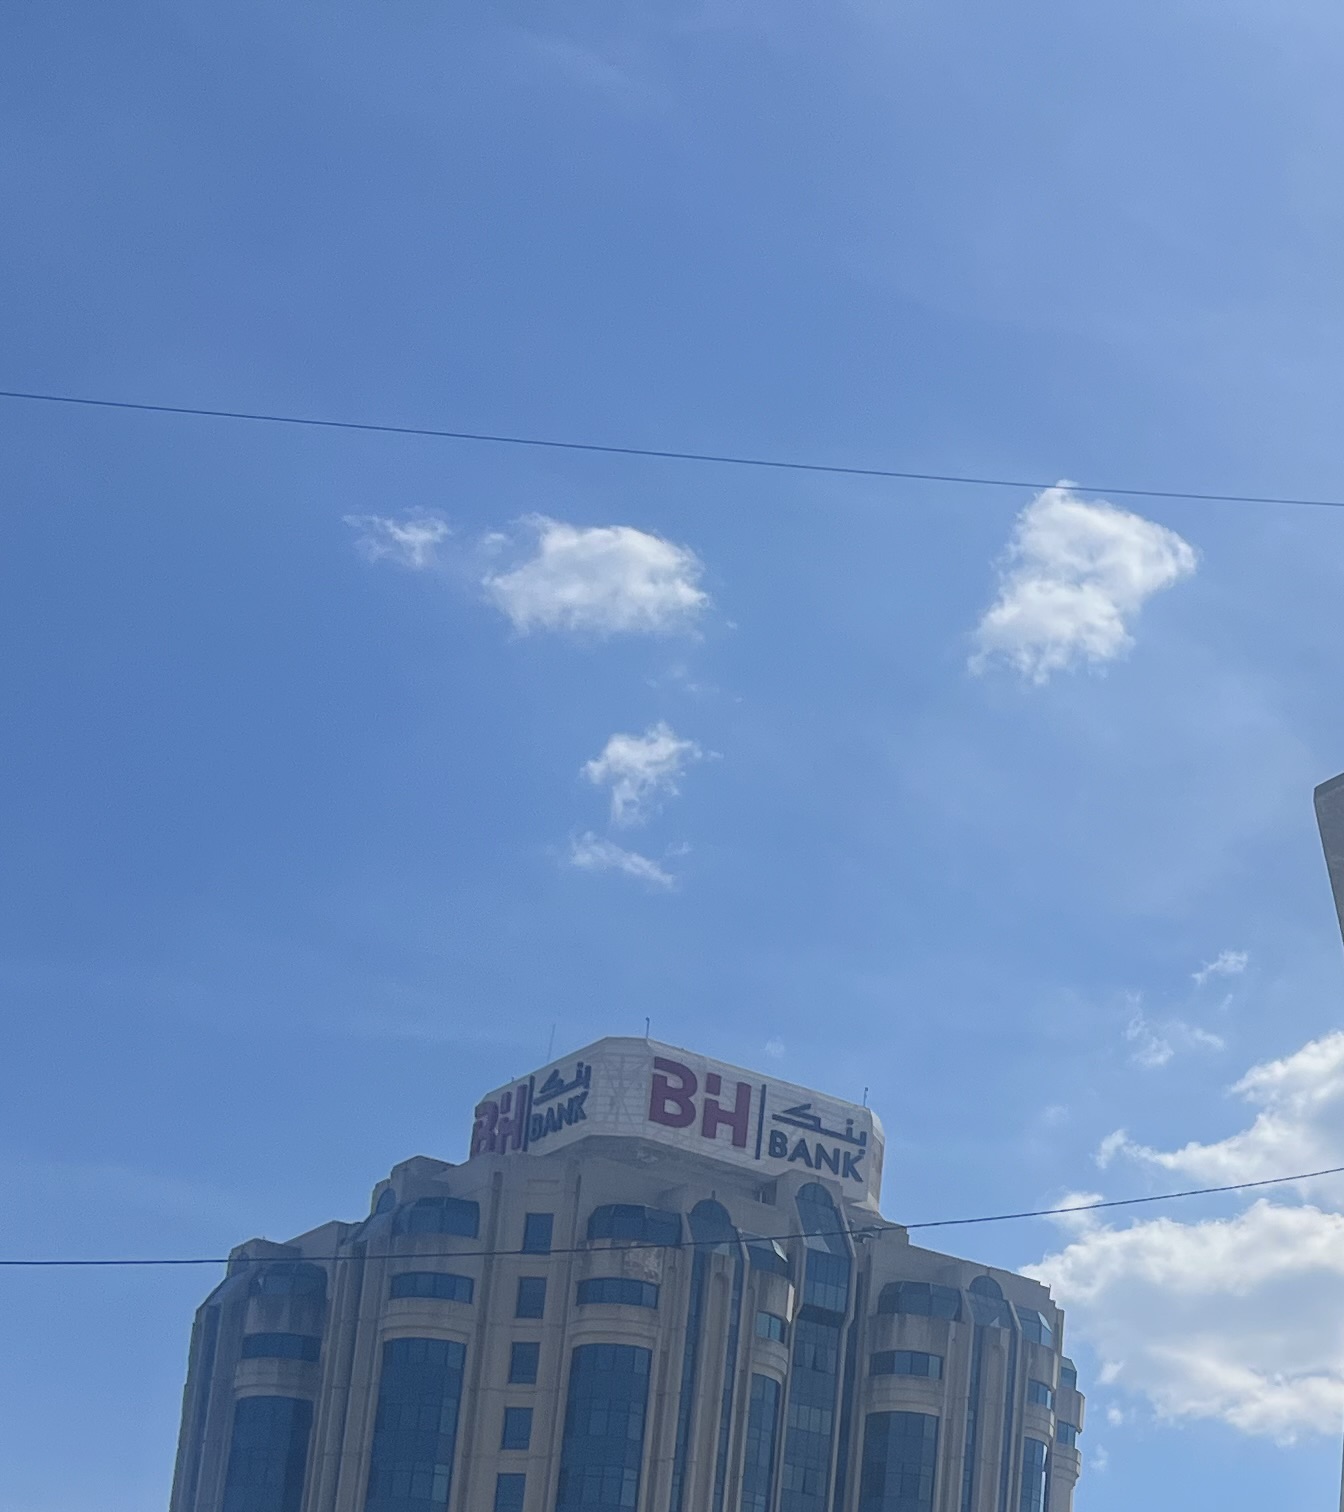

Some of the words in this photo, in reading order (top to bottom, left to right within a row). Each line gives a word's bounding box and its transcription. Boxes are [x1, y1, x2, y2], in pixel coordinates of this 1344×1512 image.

[472, 1084, 528, 1157] BH
[529, 1090, 589, 1142] BANK
[648, 1056, 752, 1149] BH
[771, 1103, 868, 1155] بنك
[768, 1129, 865, 1183] BANK
